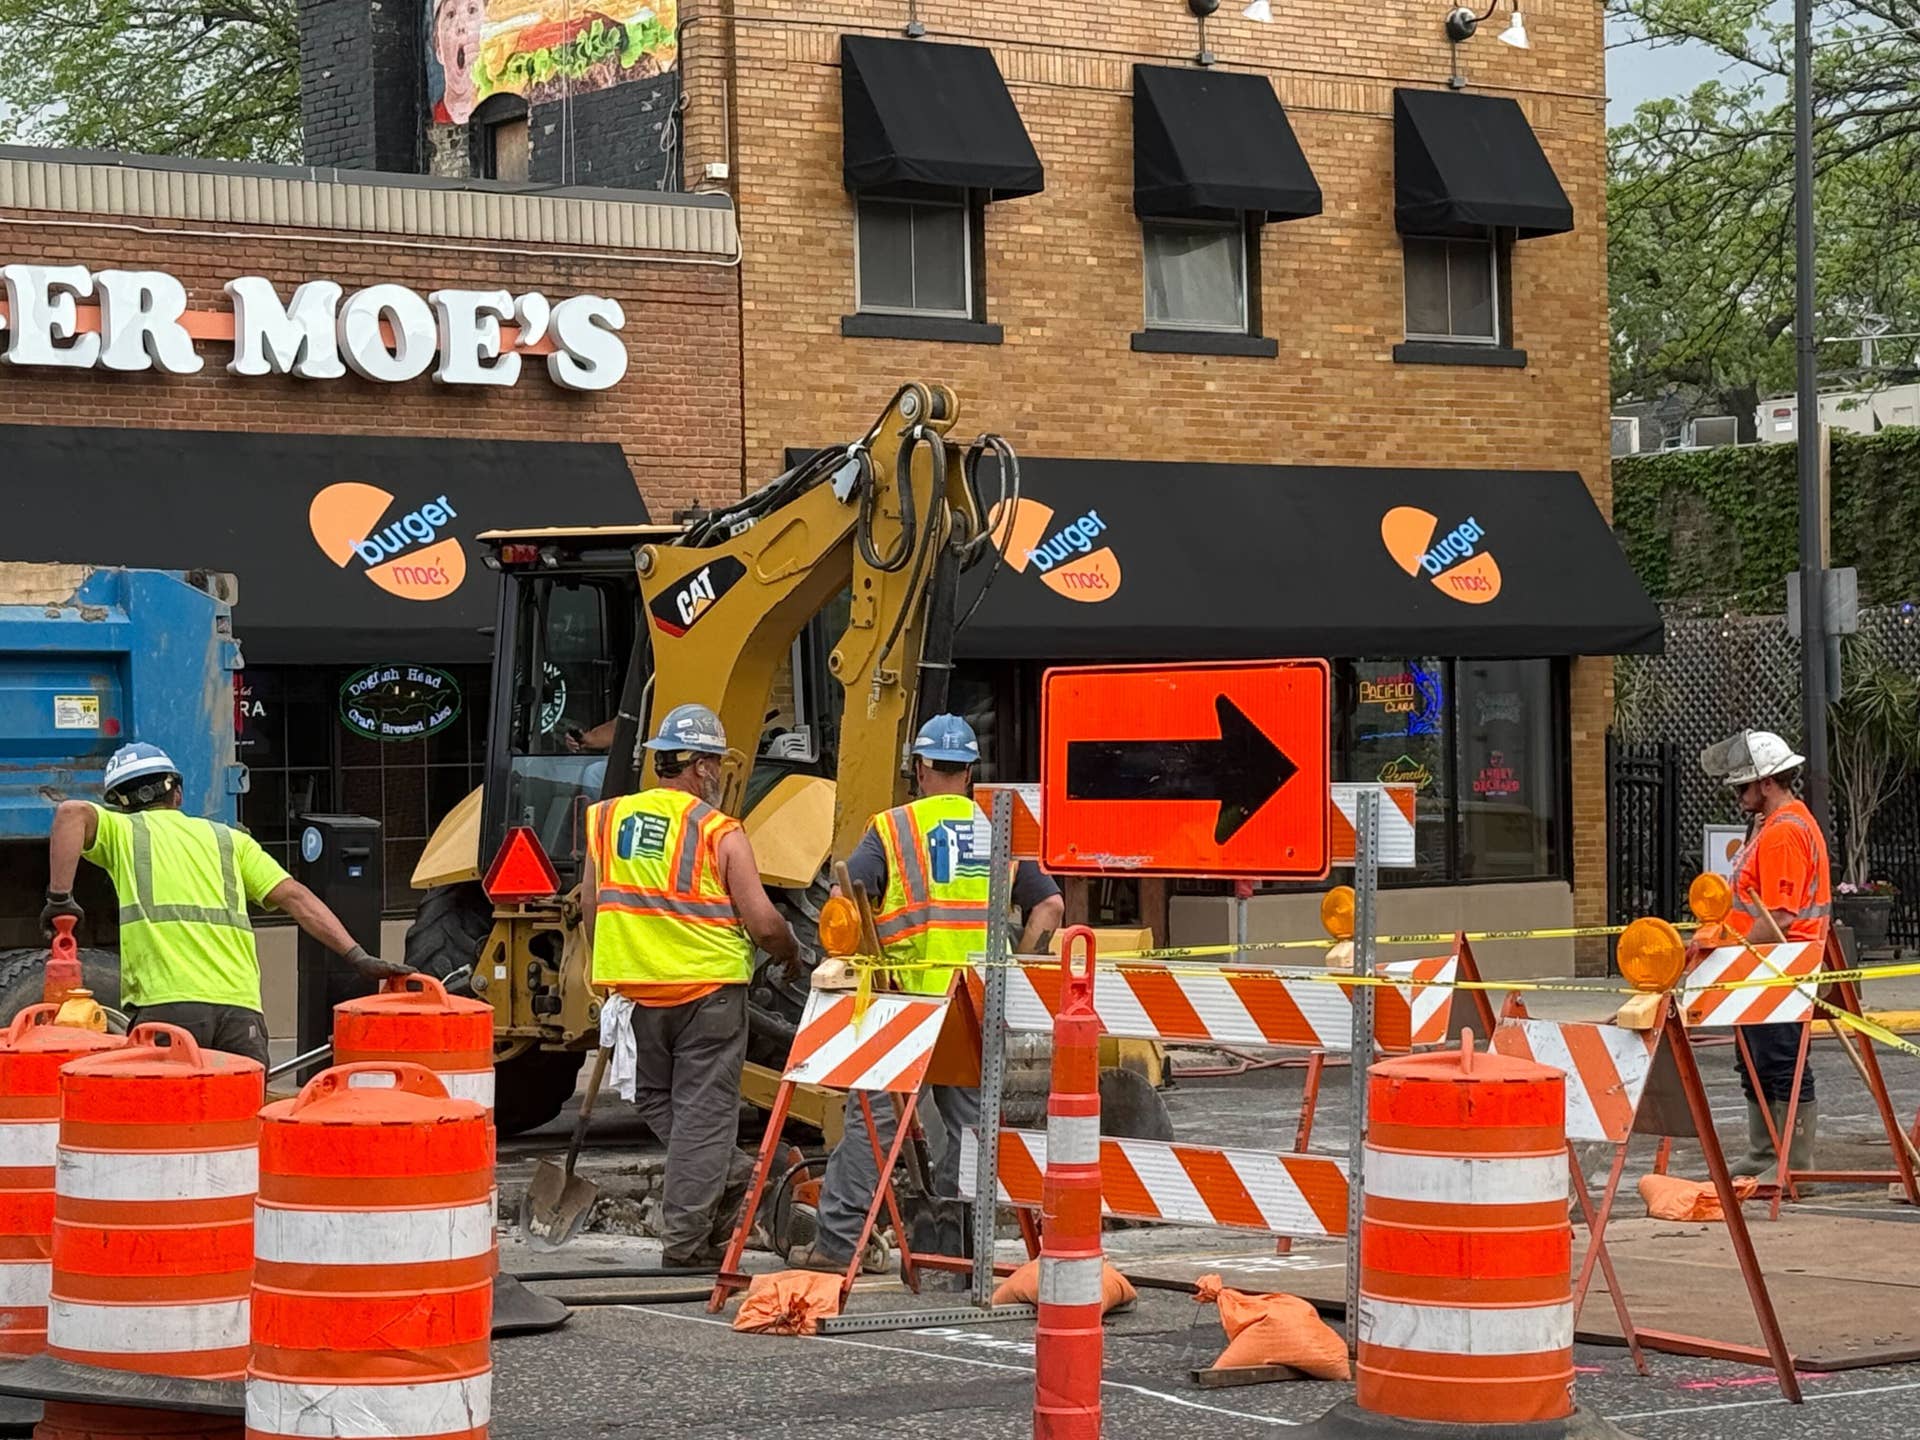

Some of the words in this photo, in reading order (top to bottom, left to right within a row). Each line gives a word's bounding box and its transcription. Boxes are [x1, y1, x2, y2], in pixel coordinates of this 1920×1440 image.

[0, 264, 205, 374] ER
[224, 276, 628, 390] MOE'S
[348, 495, 458, 565] burger
[1024, 509, 1107, 571] burger
[1414, 516, 1485, 575] burger
[392, 557, 450, 585] moe's
[1062, 563, 1110, 589] moe's
[1449, 567, 1492, 591] moe's
[676, 566, 717, 625] CAT
[407, 668, 442, 689] Head
[1359, 681, 1415, 704] PACIFICO
[382, 721, 425, 735] Brewed
[307, 833, 317, 855] P
